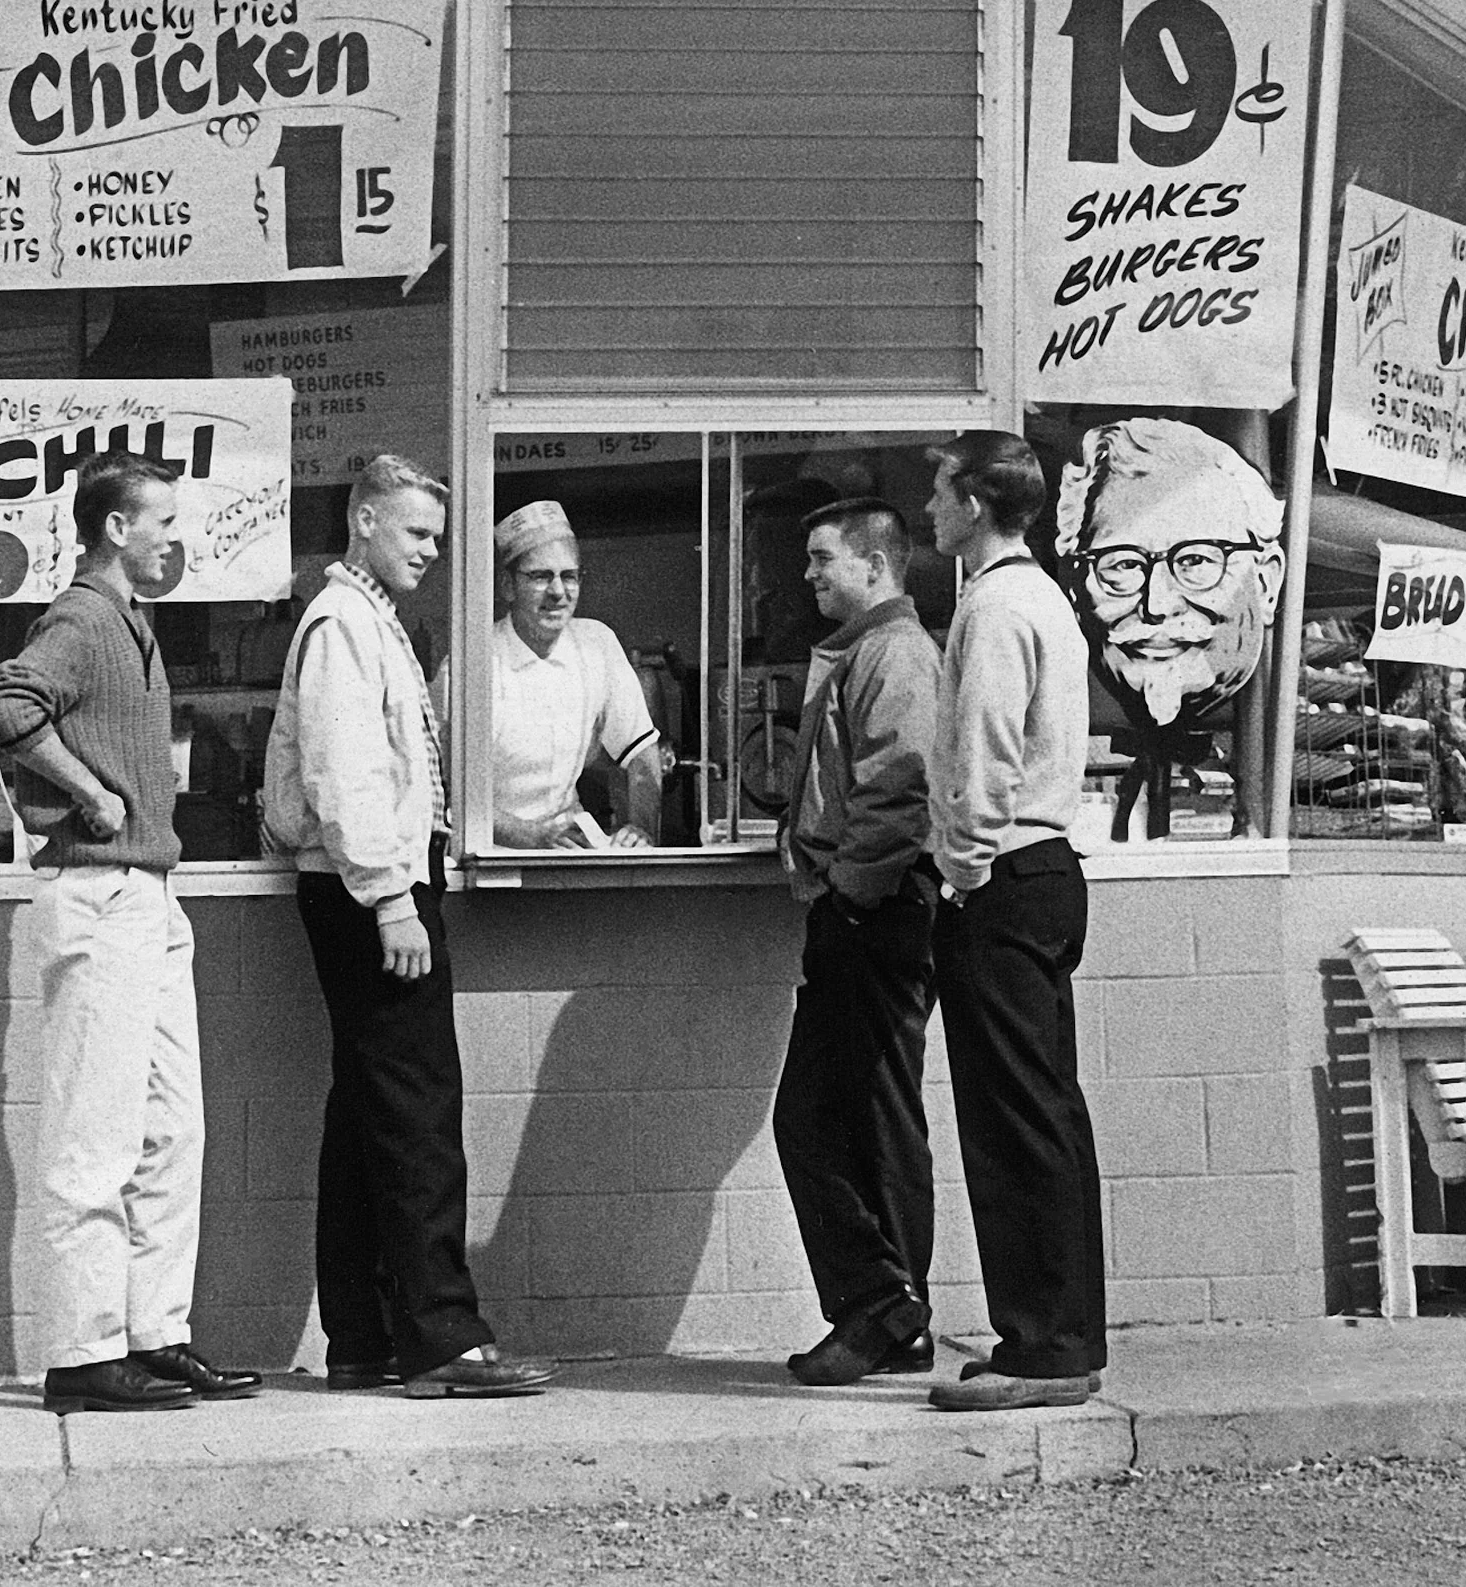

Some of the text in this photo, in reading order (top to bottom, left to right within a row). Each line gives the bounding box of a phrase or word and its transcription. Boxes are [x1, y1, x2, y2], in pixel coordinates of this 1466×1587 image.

[7, 26, 372, 148] Chicken
[88, 170, 176, 198] HONEY
[89, 201, 194, 227] PICKLES
[1064, 182, 1247, 242] SHAKES
[89, 233, 195, 262] KETCHUP
[1053, 235, 1265, 307] BURGERS
[1364, 277, 1393, 335] BOX
[241, 324, 354, 350] HAMBURGERS
[1038, 287, 1260, 372] HOT DOGS
[244, 352, 328, 373] HOT DOGS
[320, 396, 367, 416] FRIES
